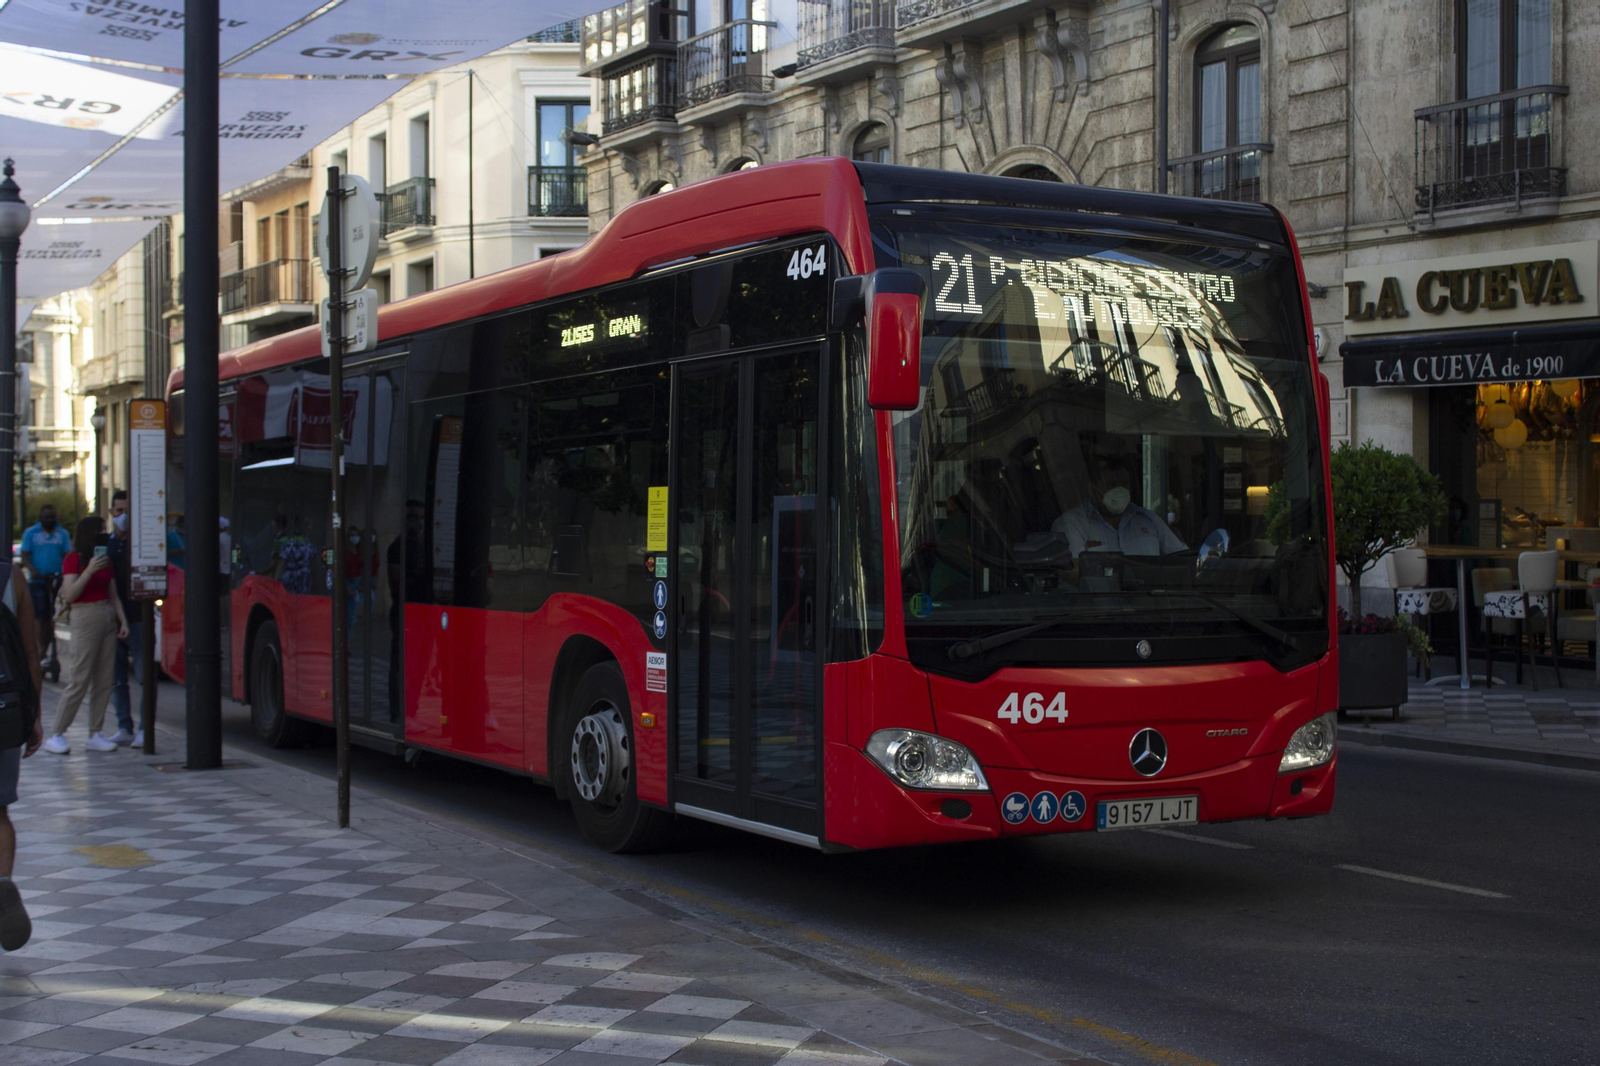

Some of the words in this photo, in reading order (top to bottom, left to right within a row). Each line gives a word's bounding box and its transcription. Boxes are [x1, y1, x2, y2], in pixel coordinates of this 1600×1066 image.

[786, 244, 826, 281] 464
[932, 252, 983, 315] 21
[1344, 276, 1410, 321] LA
[1416, 258, 1585, 315] CUEVA
[1375, 359, 1406, 383] LA
[1413, 353, 1497, 382] CUEVA
[1501, 357, 1520, 377] de
[1525, 355, 1564, 376] 1900
[997, 691, 1069, 724] 464
[1206, 728, 1248, 737] CITARO
[1108, 802, 1154, 825] 9157
[1160, 799, 1193, 821] LJT
